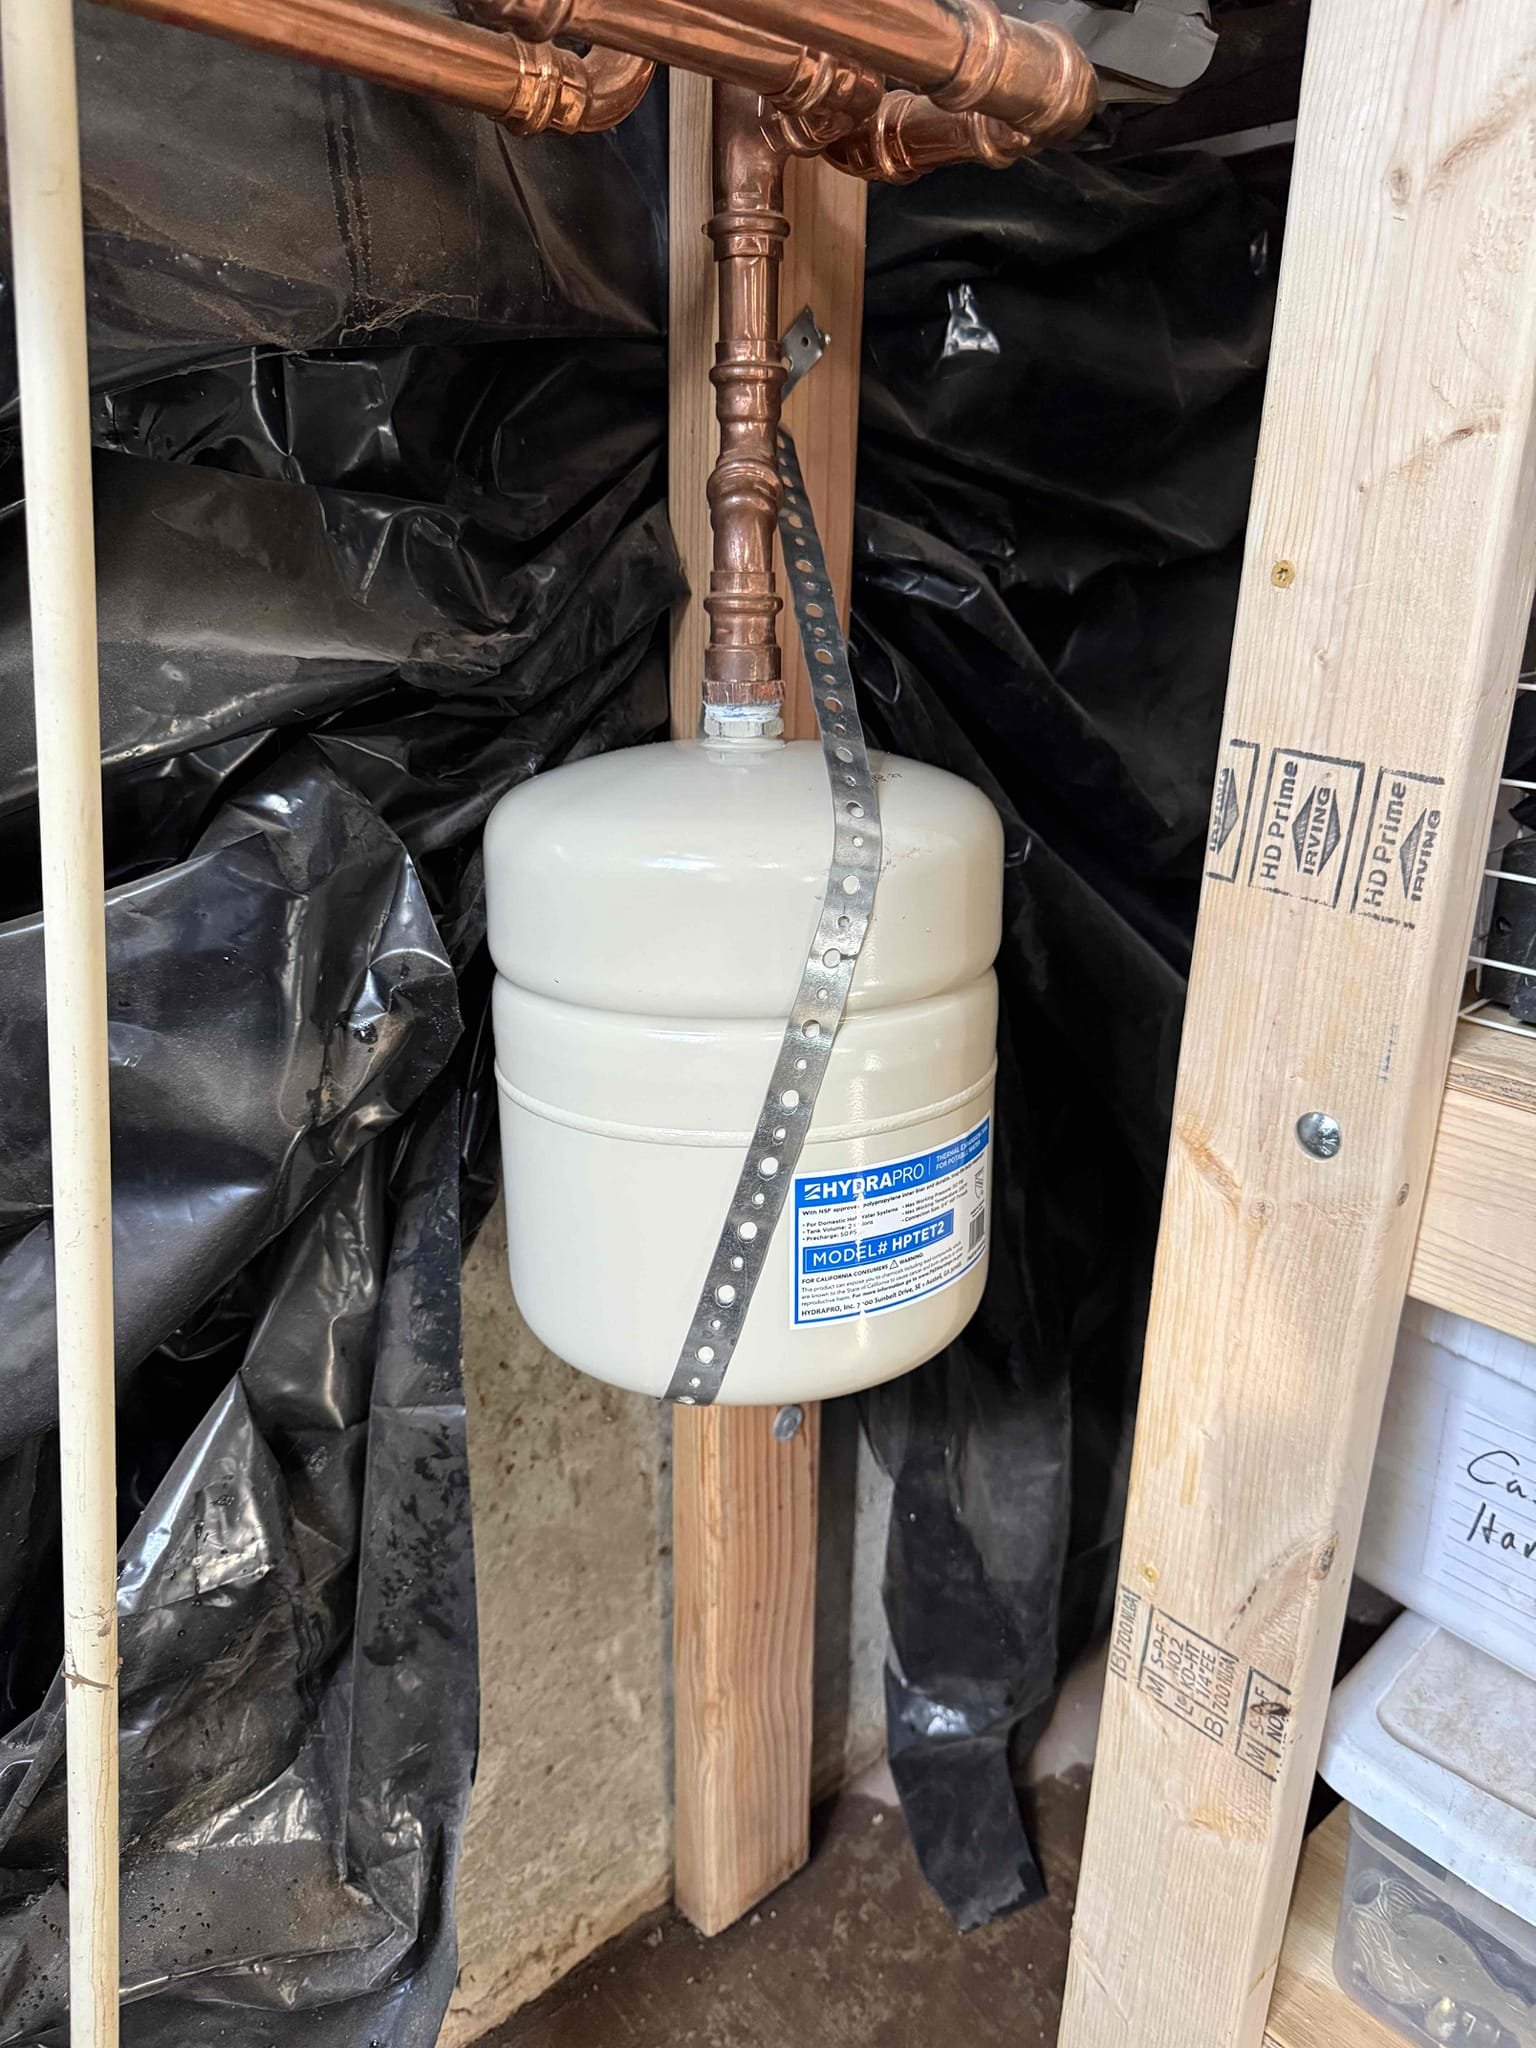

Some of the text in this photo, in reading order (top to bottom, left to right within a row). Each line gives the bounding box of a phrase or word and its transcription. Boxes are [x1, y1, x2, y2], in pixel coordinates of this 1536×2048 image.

[1260, 760, 1298, 880] HD Prime
[1303, 787, 1331, 876] IRVING
[1363, 781, 1407, 907] HD Prime
[1411, 810, 1441, 902] IRVING
[822, 1163, 924, 1199] HYDRAPRO
[813, 1240, 888, 1267] MODEL#
[891, 1220, 945, 1252] HPTET2
[818, 1218, 846, 1226] Domestic
[816, 1272, 852, 1283] CALIFORNIA
[853, 1263, 888, 1277] CONSUMERS
[802, 1305, 843, 1317] HYDRAPRO,
[1180, 1640, 1201, 1691] KD-HT
[1204, 1715, 1224, 1739] B
